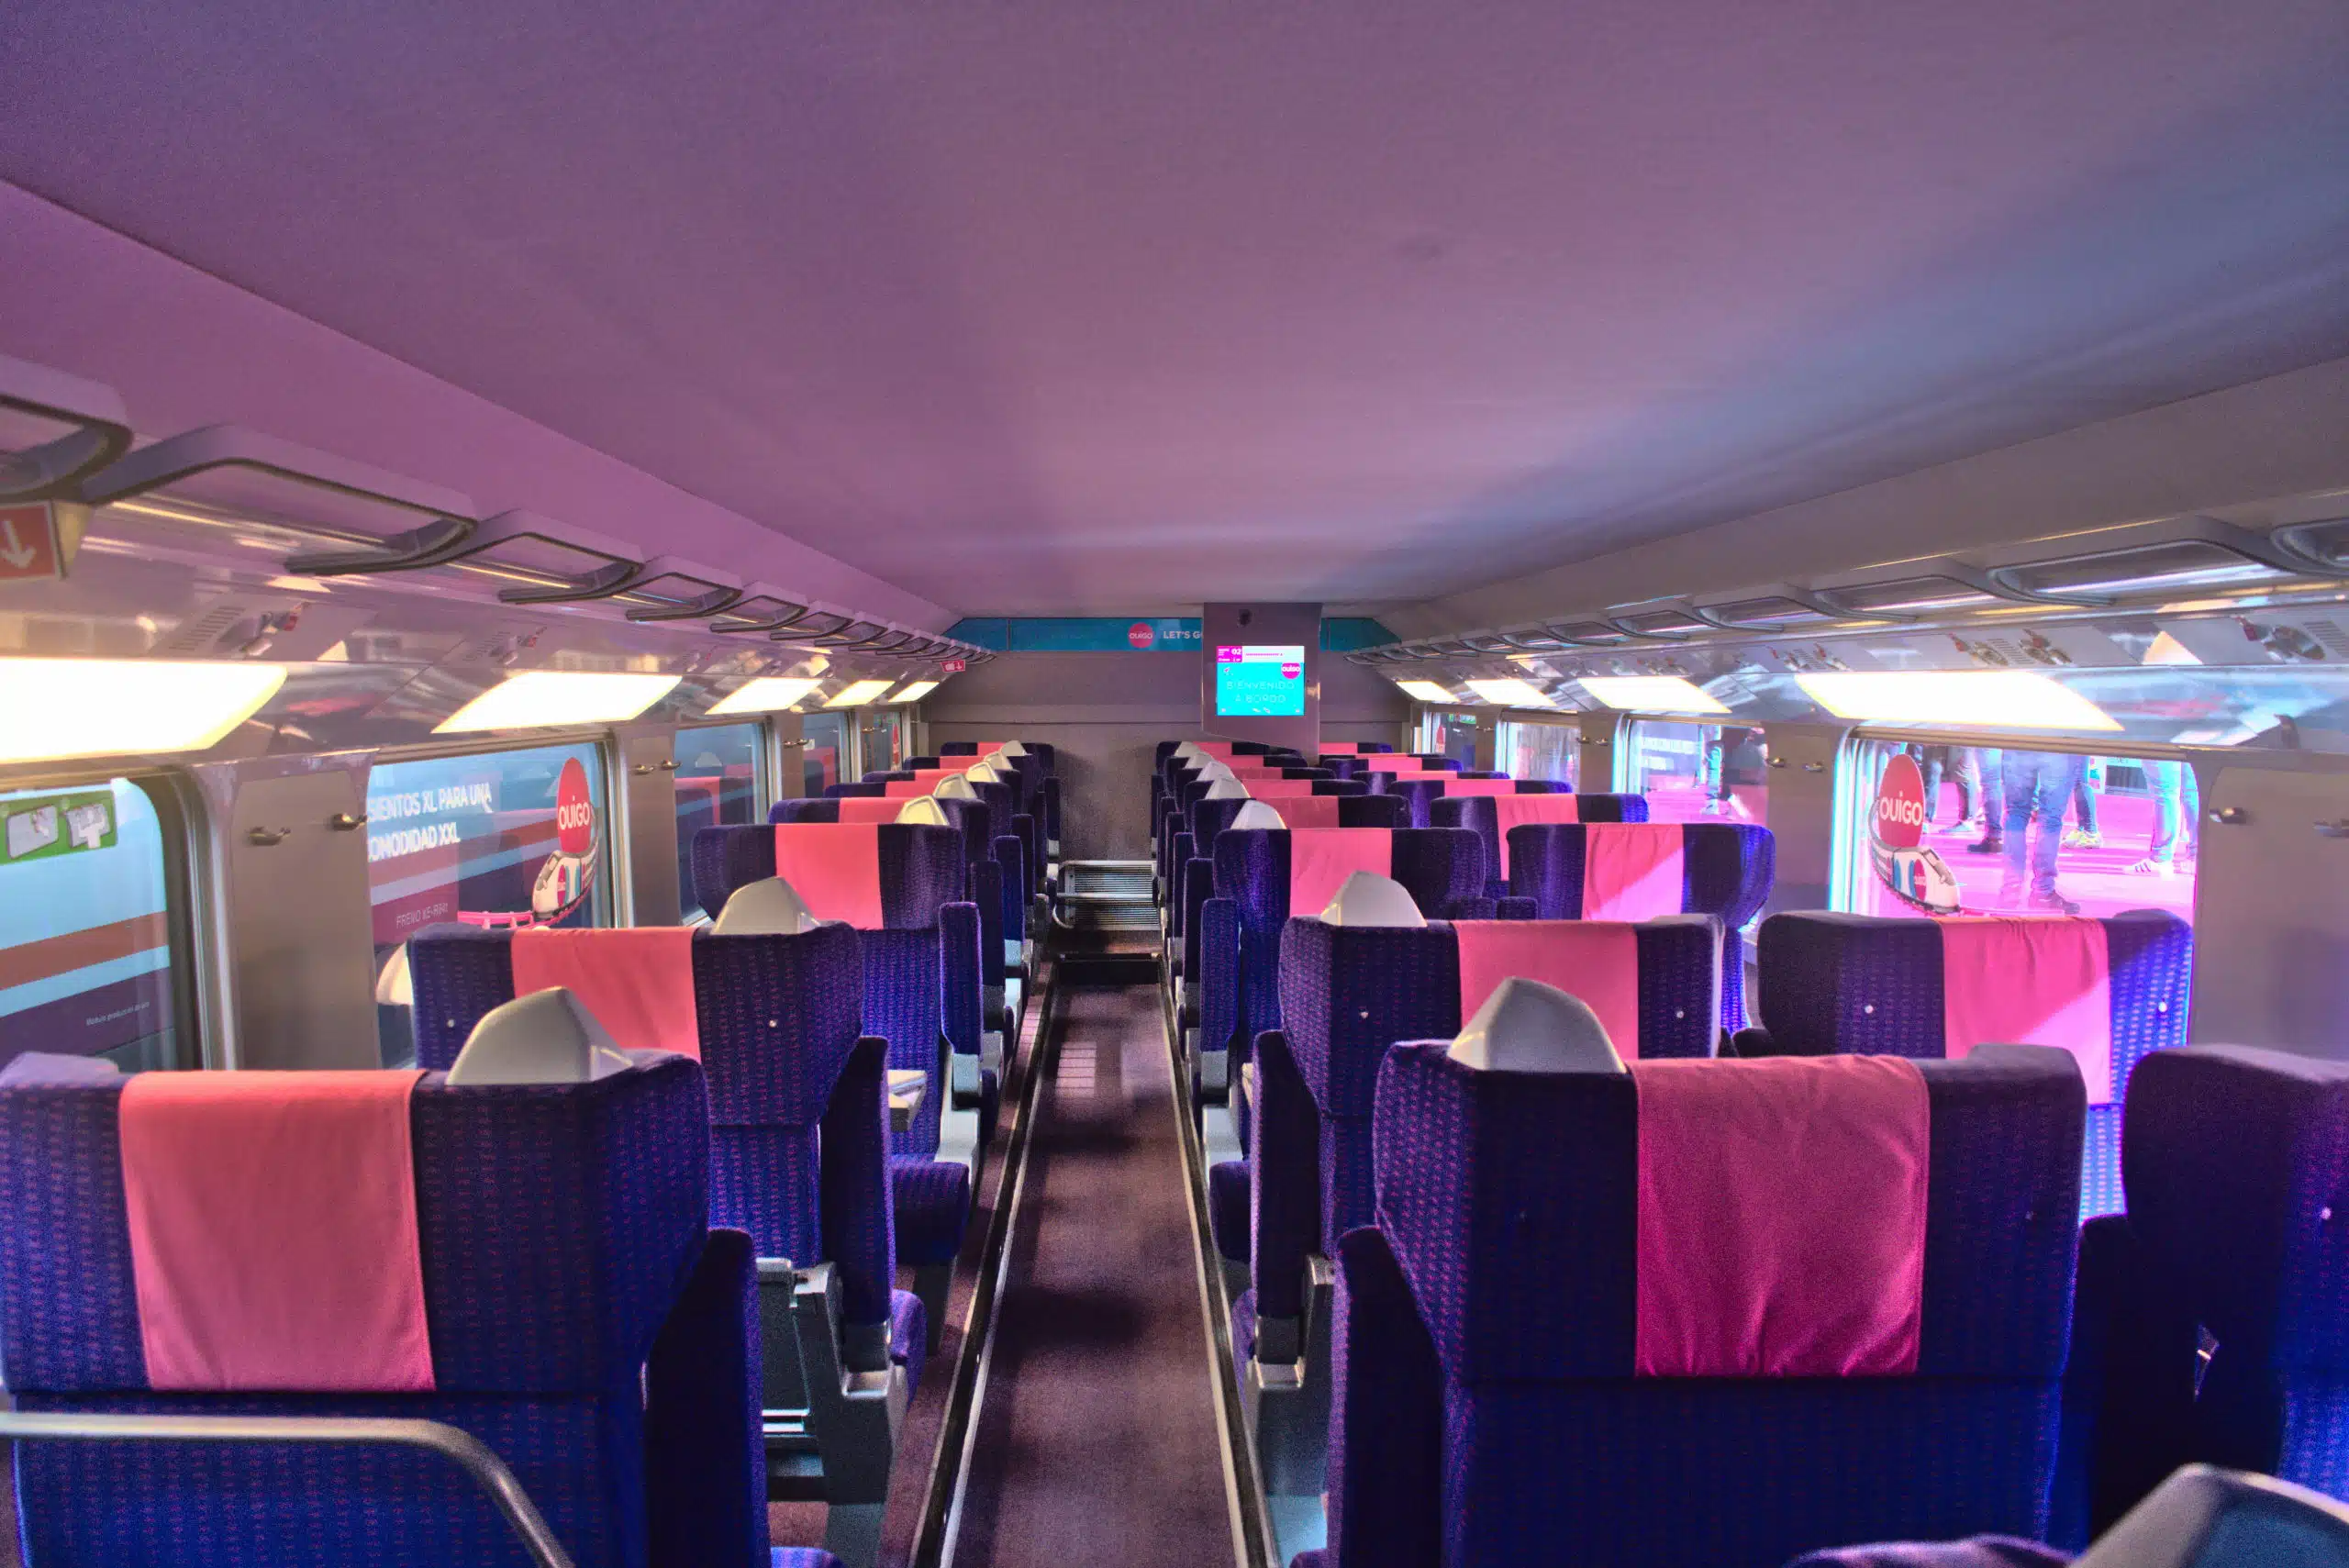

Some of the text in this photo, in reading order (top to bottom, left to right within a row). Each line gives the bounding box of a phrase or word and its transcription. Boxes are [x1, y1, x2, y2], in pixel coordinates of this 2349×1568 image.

[1163, 630, 1190, 639] LET'S
[1192, 630, 1204, 639] G
[1226, 681, 1295, 690] BIENVENIDO
[1245, 694, 1286, 704] BORDO
[422, 790, 438, 815] XL
[438, 785, 469, 810] PARA
[367, 821, 461, 862] OMODIDAD XXL
